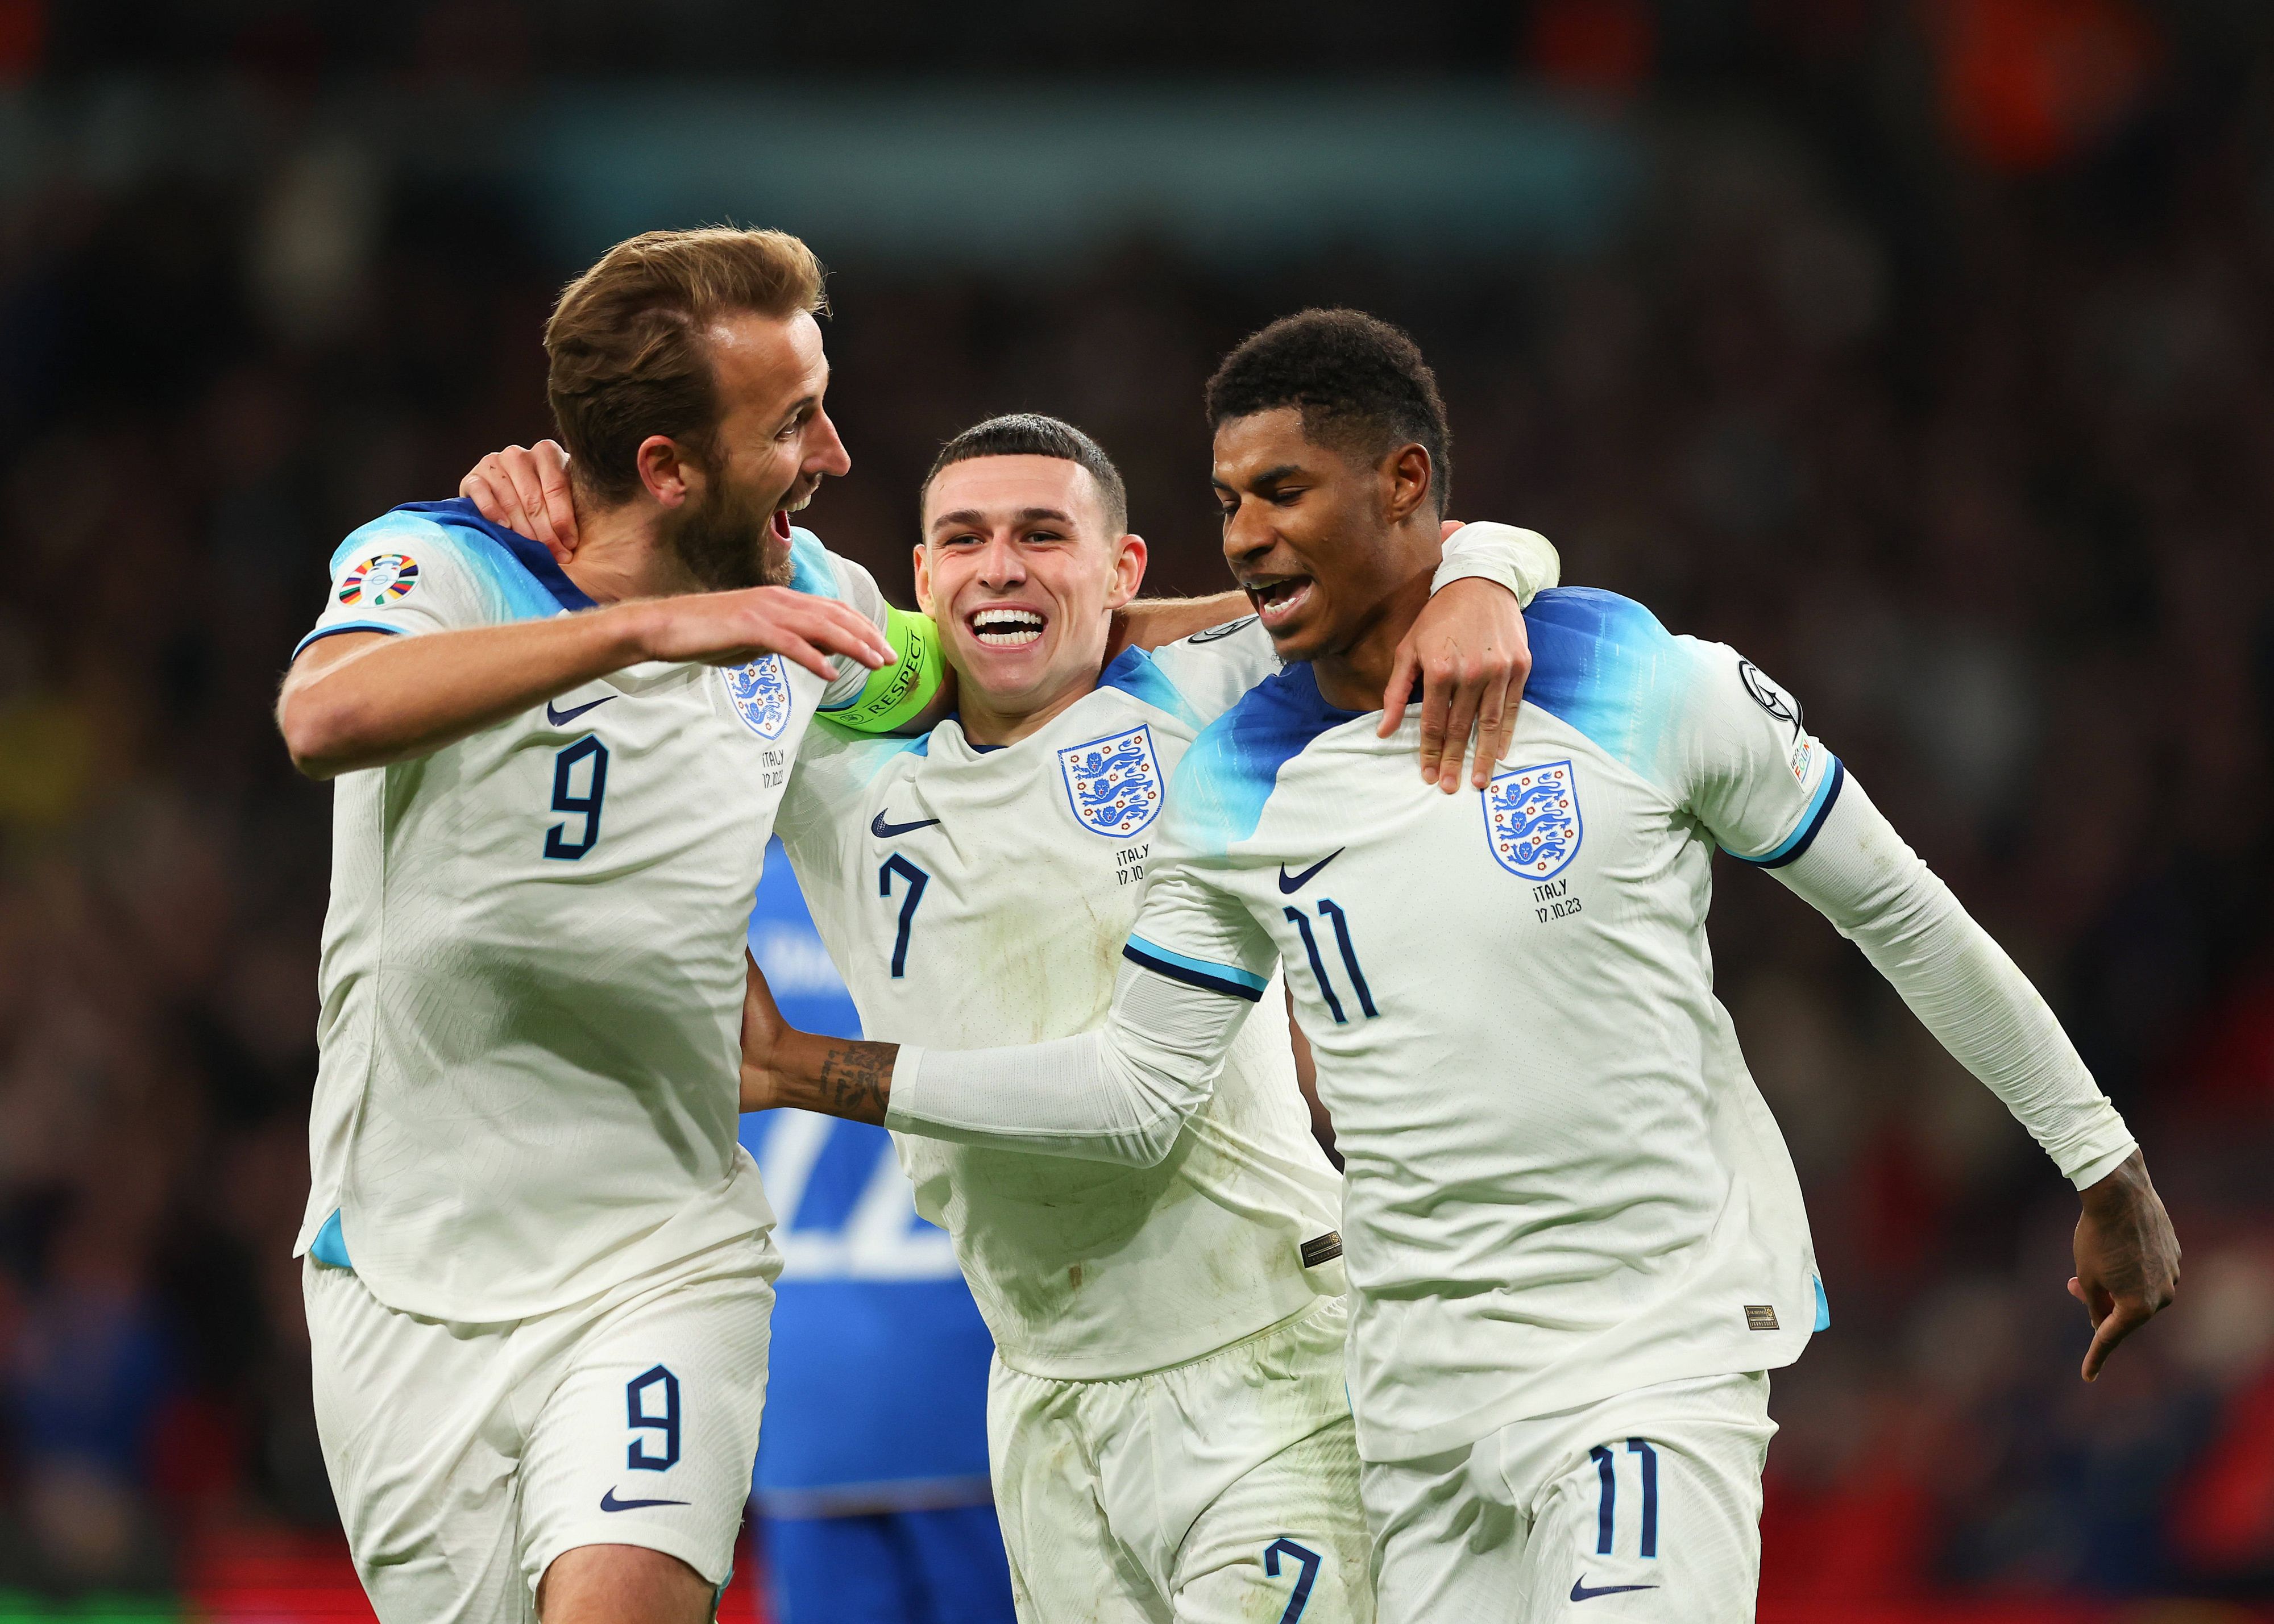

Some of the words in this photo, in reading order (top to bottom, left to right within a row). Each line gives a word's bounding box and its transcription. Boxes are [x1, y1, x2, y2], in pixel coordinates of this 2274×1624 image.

[868, 629, 921, 714] RESPECT
[543, 733, 609, 862] 9
[879, 851, 931, 979] 7
[1283, 898, 1380, 1024] 11
[1535, 898, 1582, 924] 17.10.23
[626, 1363, 681, 1473] 9
[1589, 1437, 1659, 1560] 11
[1263, 1537, 1323, 1624] 7
